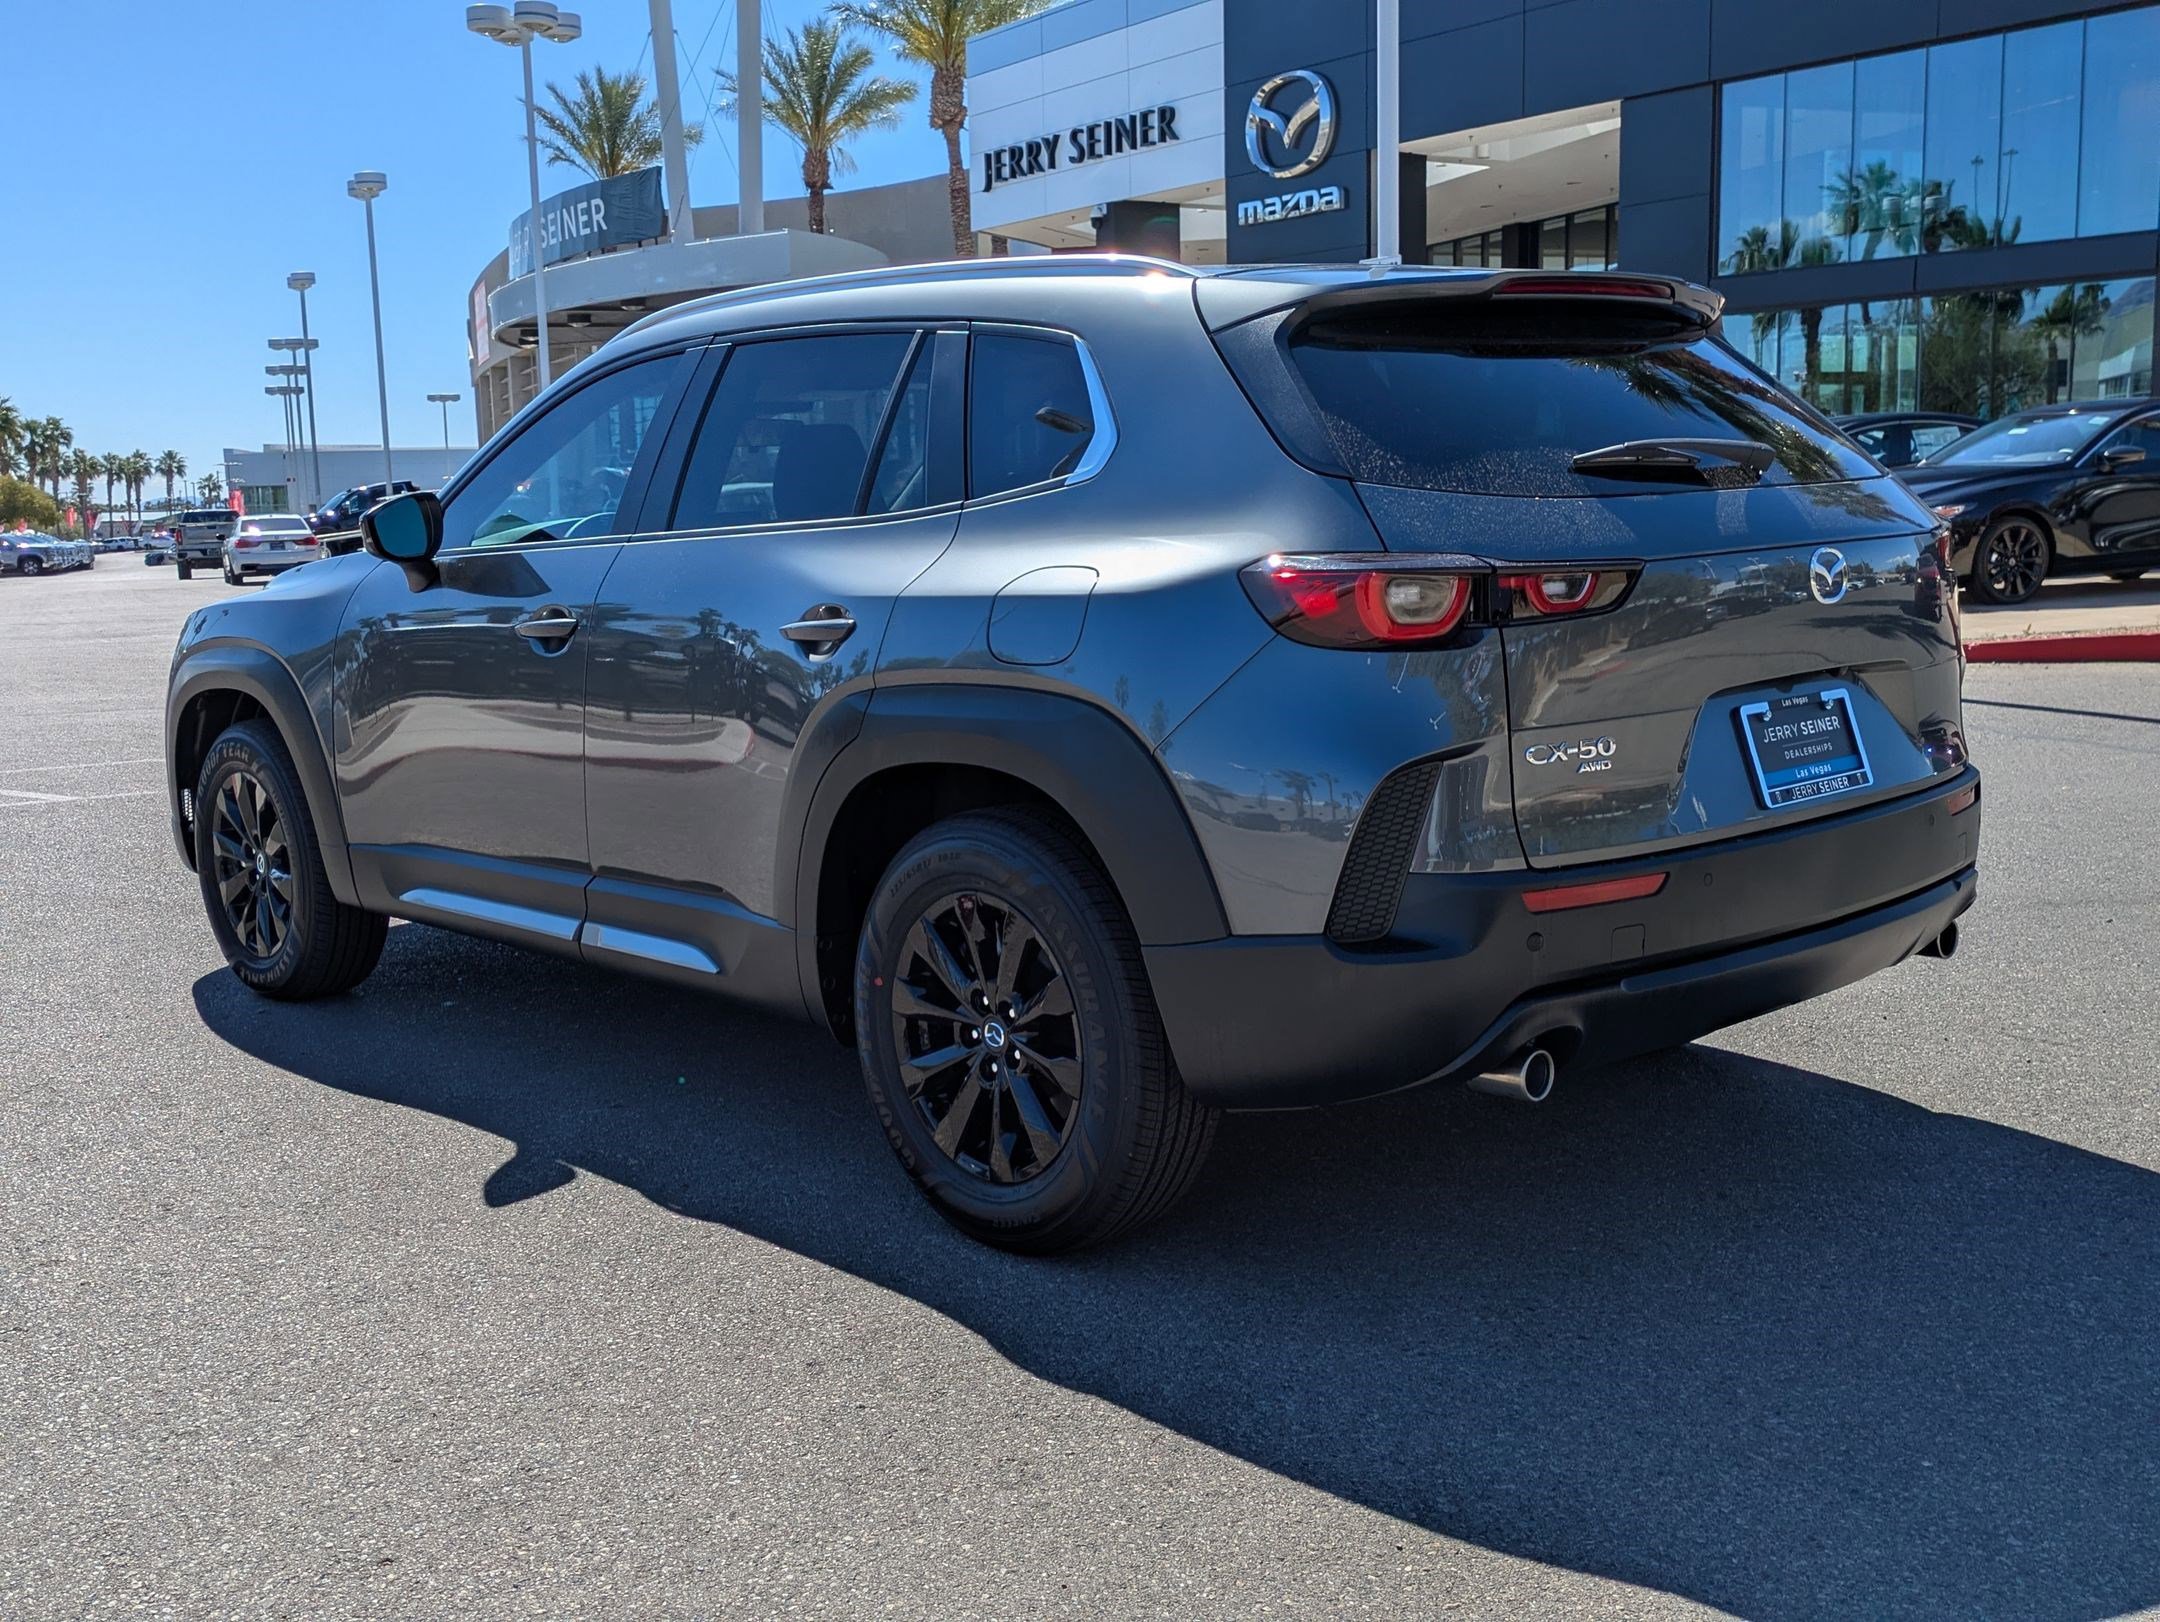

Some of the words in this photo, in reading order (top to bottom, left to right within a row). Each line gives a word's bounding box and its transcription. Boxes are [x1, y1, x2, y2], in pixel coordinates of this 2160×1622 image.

[982, 134, 1061, 193] JERRY
[1068, 105, 1180, 164] SEINER
[1238, 185, 1345, 226] mazda
[540, 197, 608, 249] SEINER
[1781, 698, 1792, 707] Las
[1792, 695, 1809, 706] Vegas
[1763, 725, 1800, 744] JERRY
[1800, 716, 1841, 735] SEINER
[1525, 736, 1616, 765] CX-50
[1784, 742, 1833, 760] DEALERSHIPS
[1577, 760, 1612, 774] AWD
[1795, 767, 1809, 779] Las
[1809, 763, 1832, 775] Vegas
[1792, 783, 1819, 800] JERRY
[1819, 776, 1850, 793] SEINER
